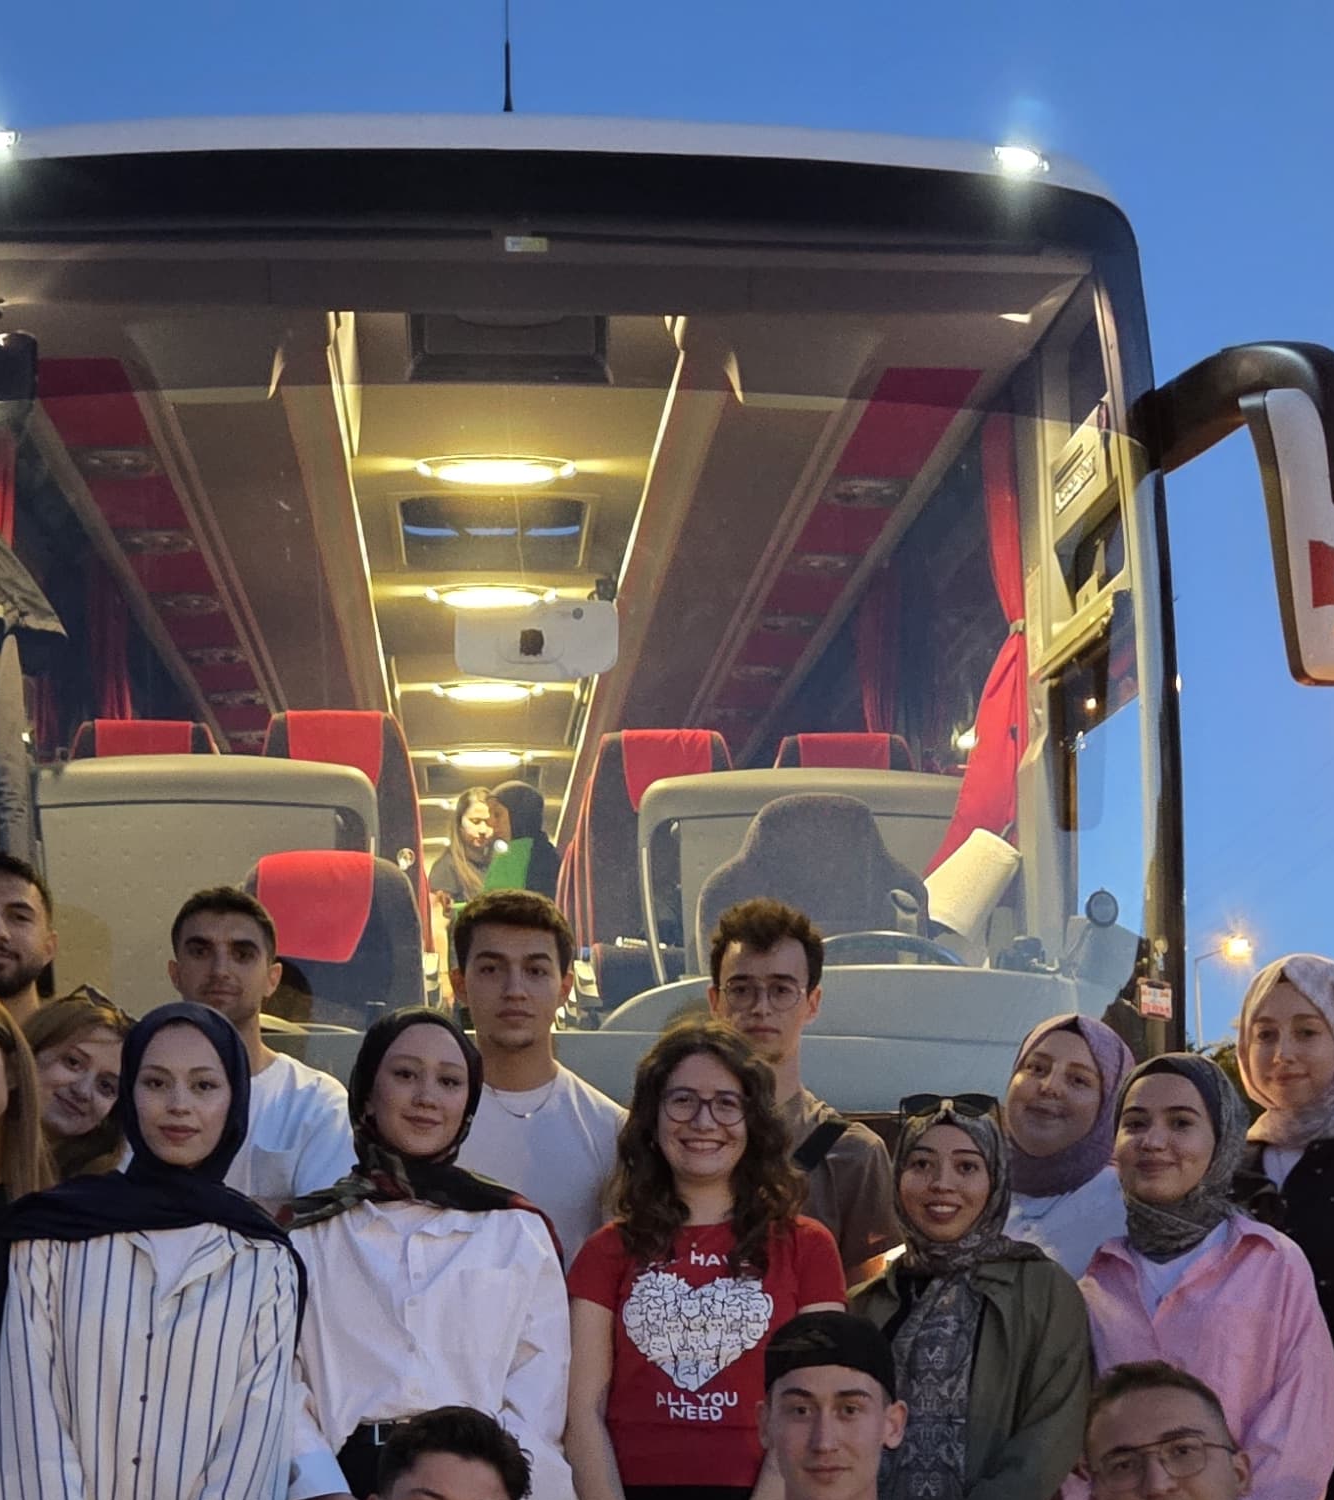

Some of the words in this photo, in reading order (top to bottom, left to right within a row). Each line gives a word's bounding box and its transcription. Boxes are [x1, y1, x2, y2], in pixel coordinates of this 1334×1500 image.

[690, 1250, 733, 1267] HA
[656, 1391, 693, 1408] ALL
[696, 1391, 739, 1407] YOU
[669, 1405, 723, 1421] NEED
